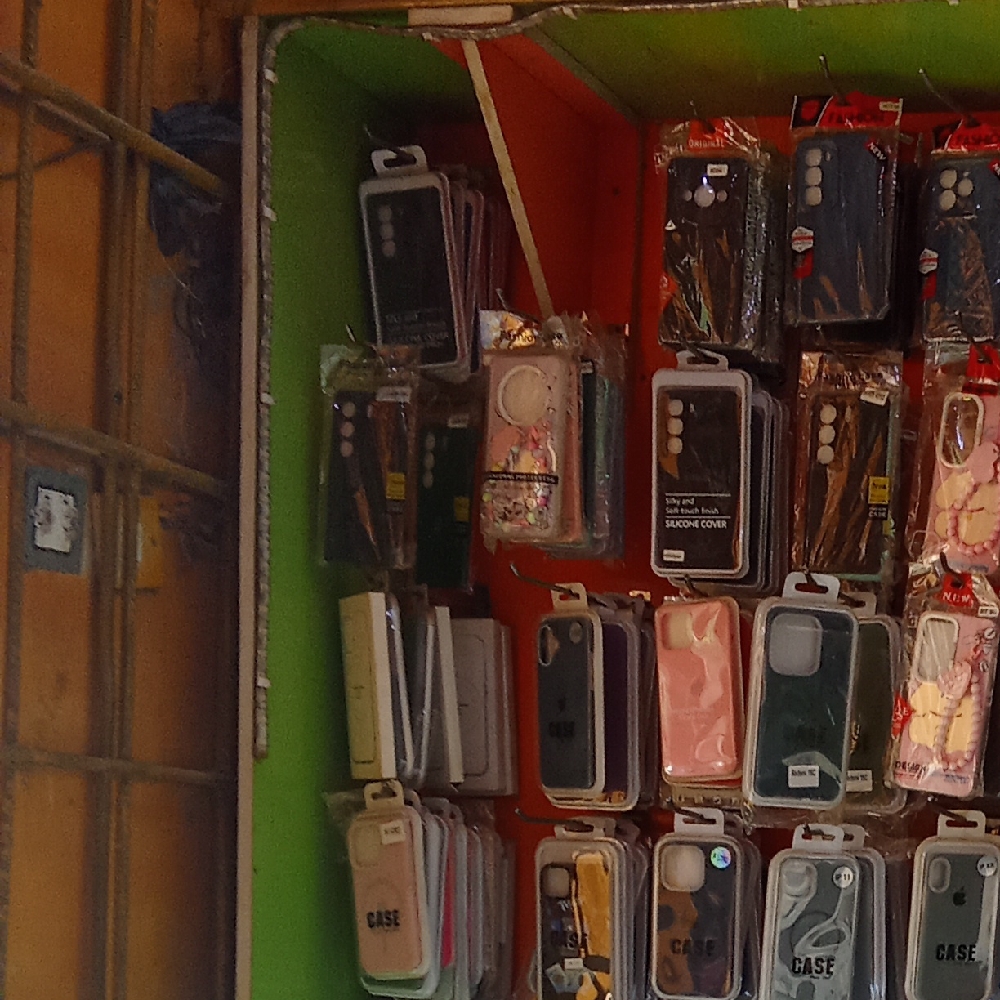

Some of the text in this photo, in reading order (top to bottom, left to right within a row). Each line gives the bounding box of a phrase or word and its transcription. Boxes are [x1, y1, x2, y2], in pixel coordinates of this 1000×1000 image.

[665, 519, 728, 529] SILICONE COVER
[942, 592, 973, 609] NEW
[366, 910, 401, 930] CASE
[671, 938, 716, 955] CASE
[936, 943, 976, 962] CASE
[791, 957, 836, 977] CASE
